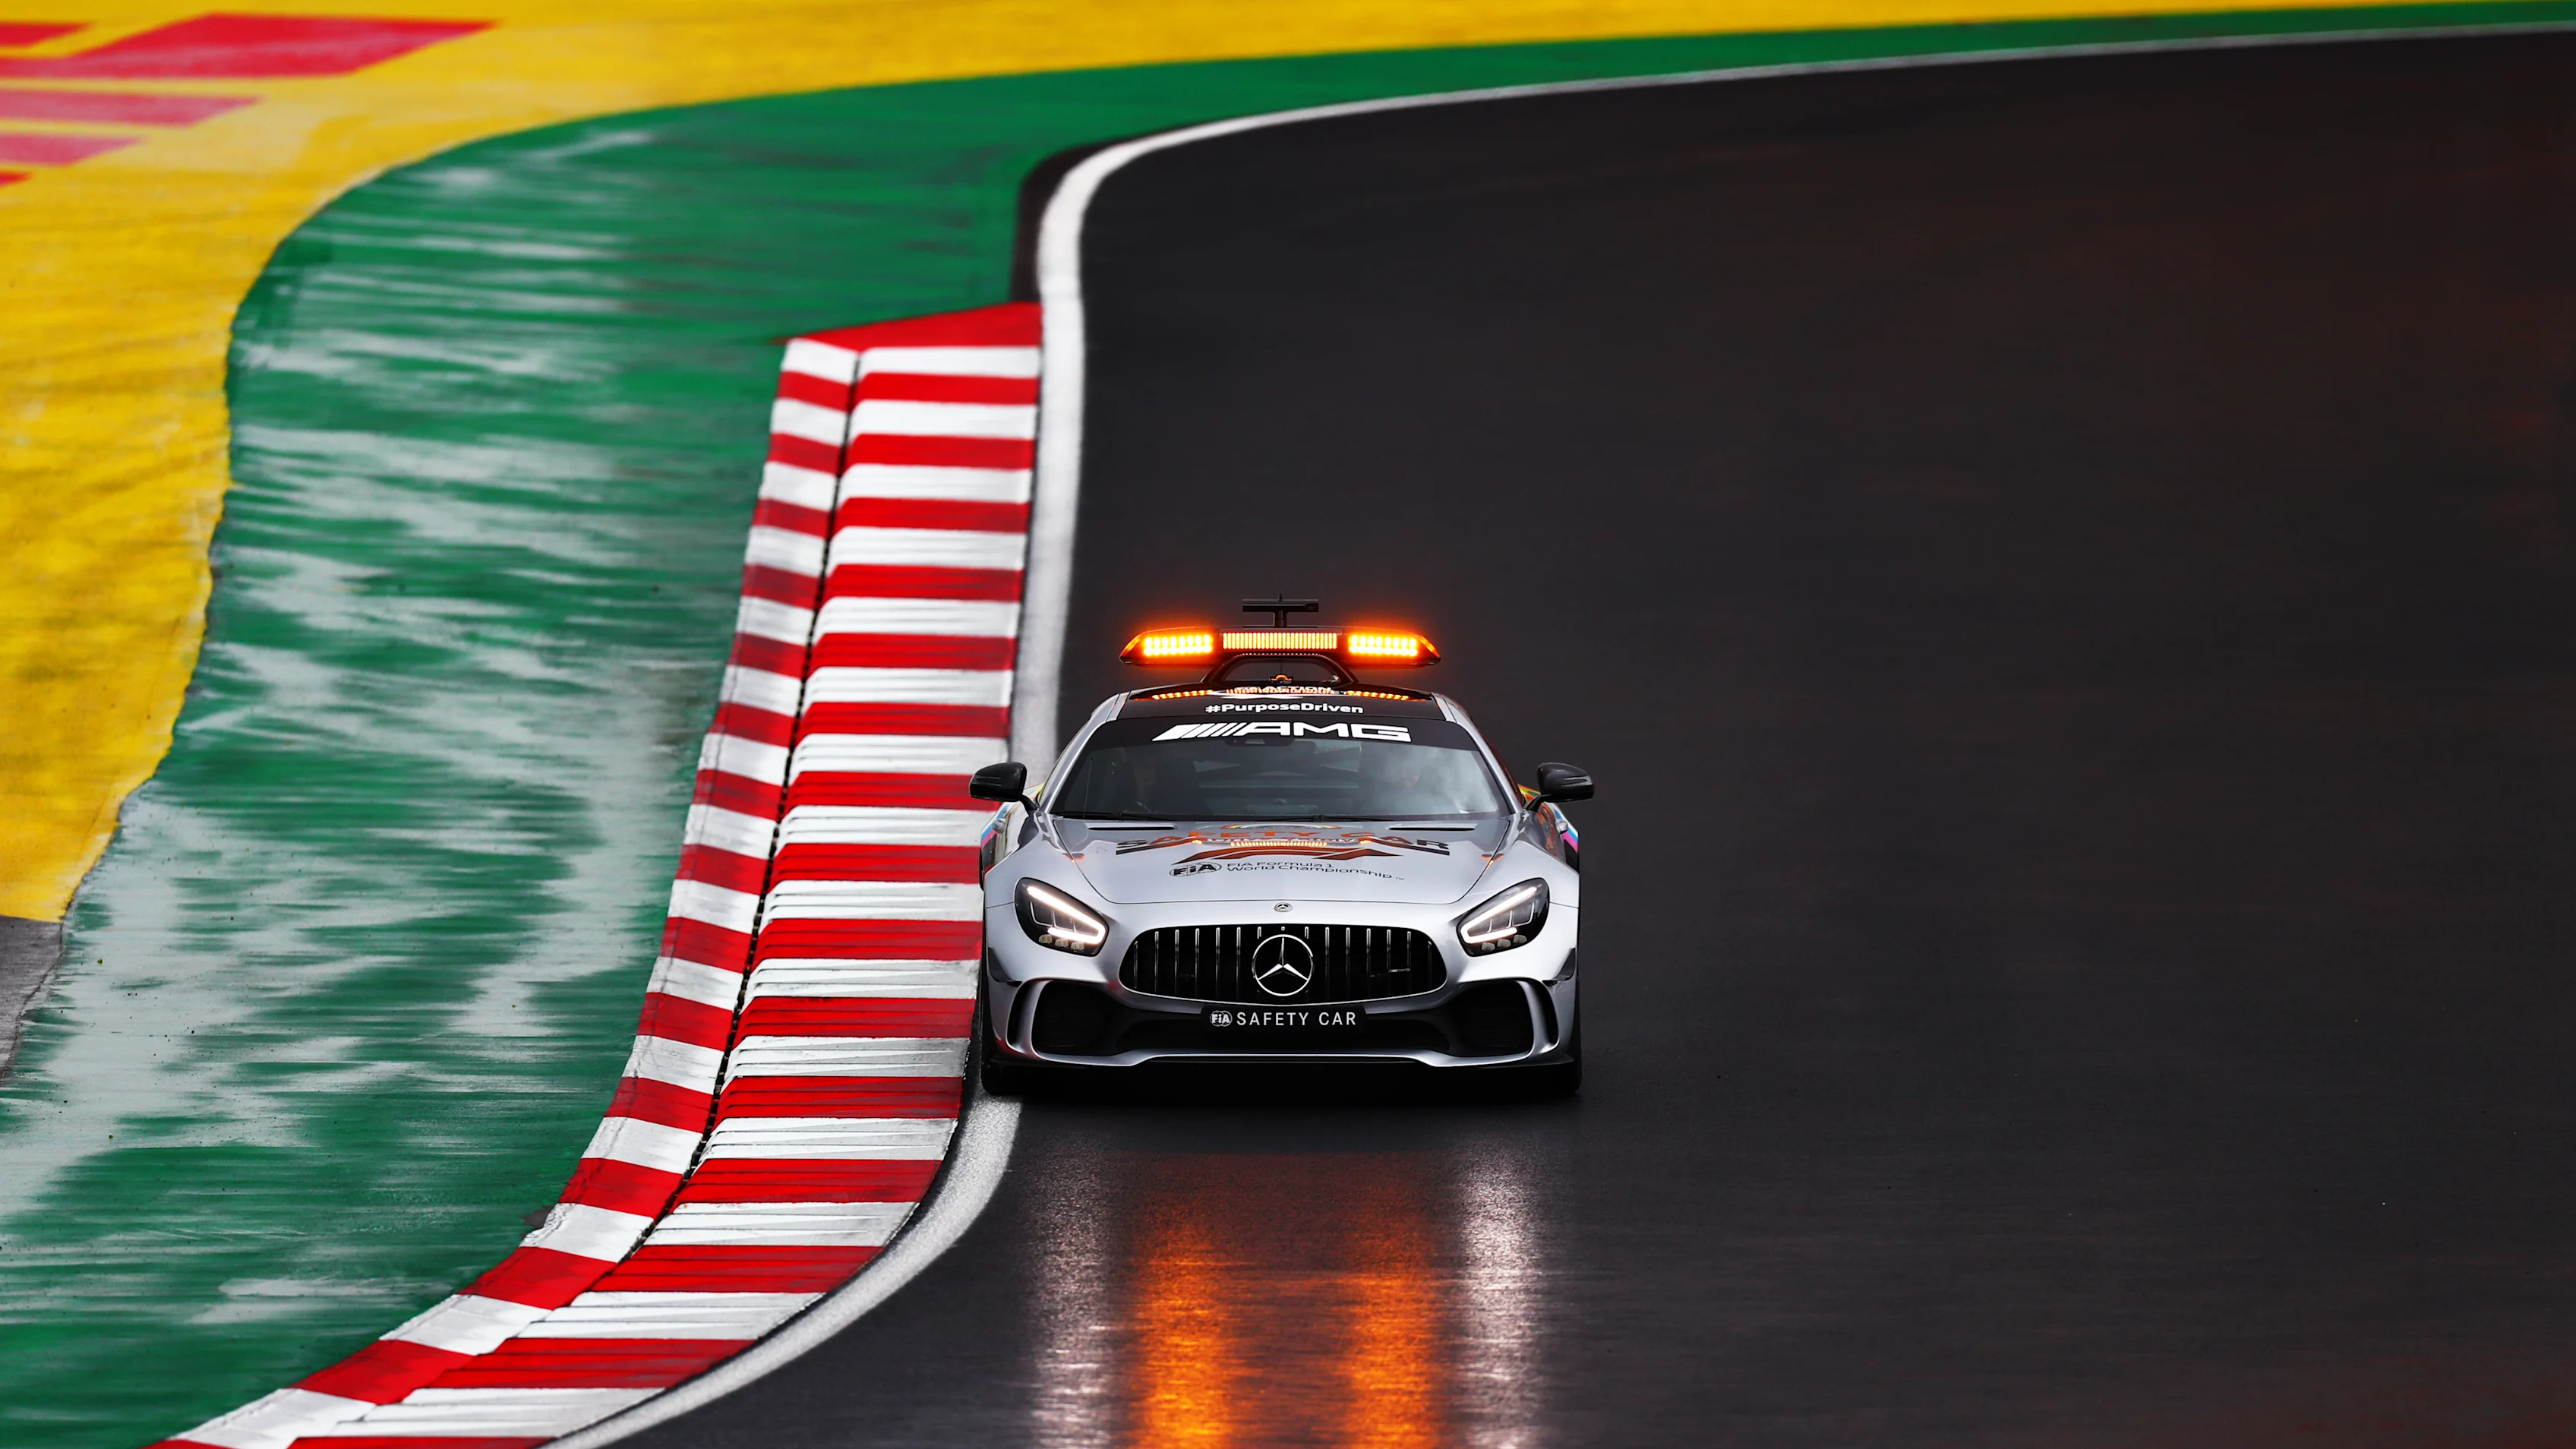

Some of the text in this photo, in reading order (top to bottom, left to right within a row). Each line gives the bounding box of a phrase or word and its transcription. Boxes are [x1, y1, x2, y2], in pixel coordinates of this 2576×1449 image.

[1205, 702, 1364, 714] #PurposeDriven
[1233, 722, 1412, 742] AMG
[1279, 865, 1392, 879] Championship
[1236, 1012, 1309, 1025] SAFETY
[1318, 1012, 1356, 1025] CAR
